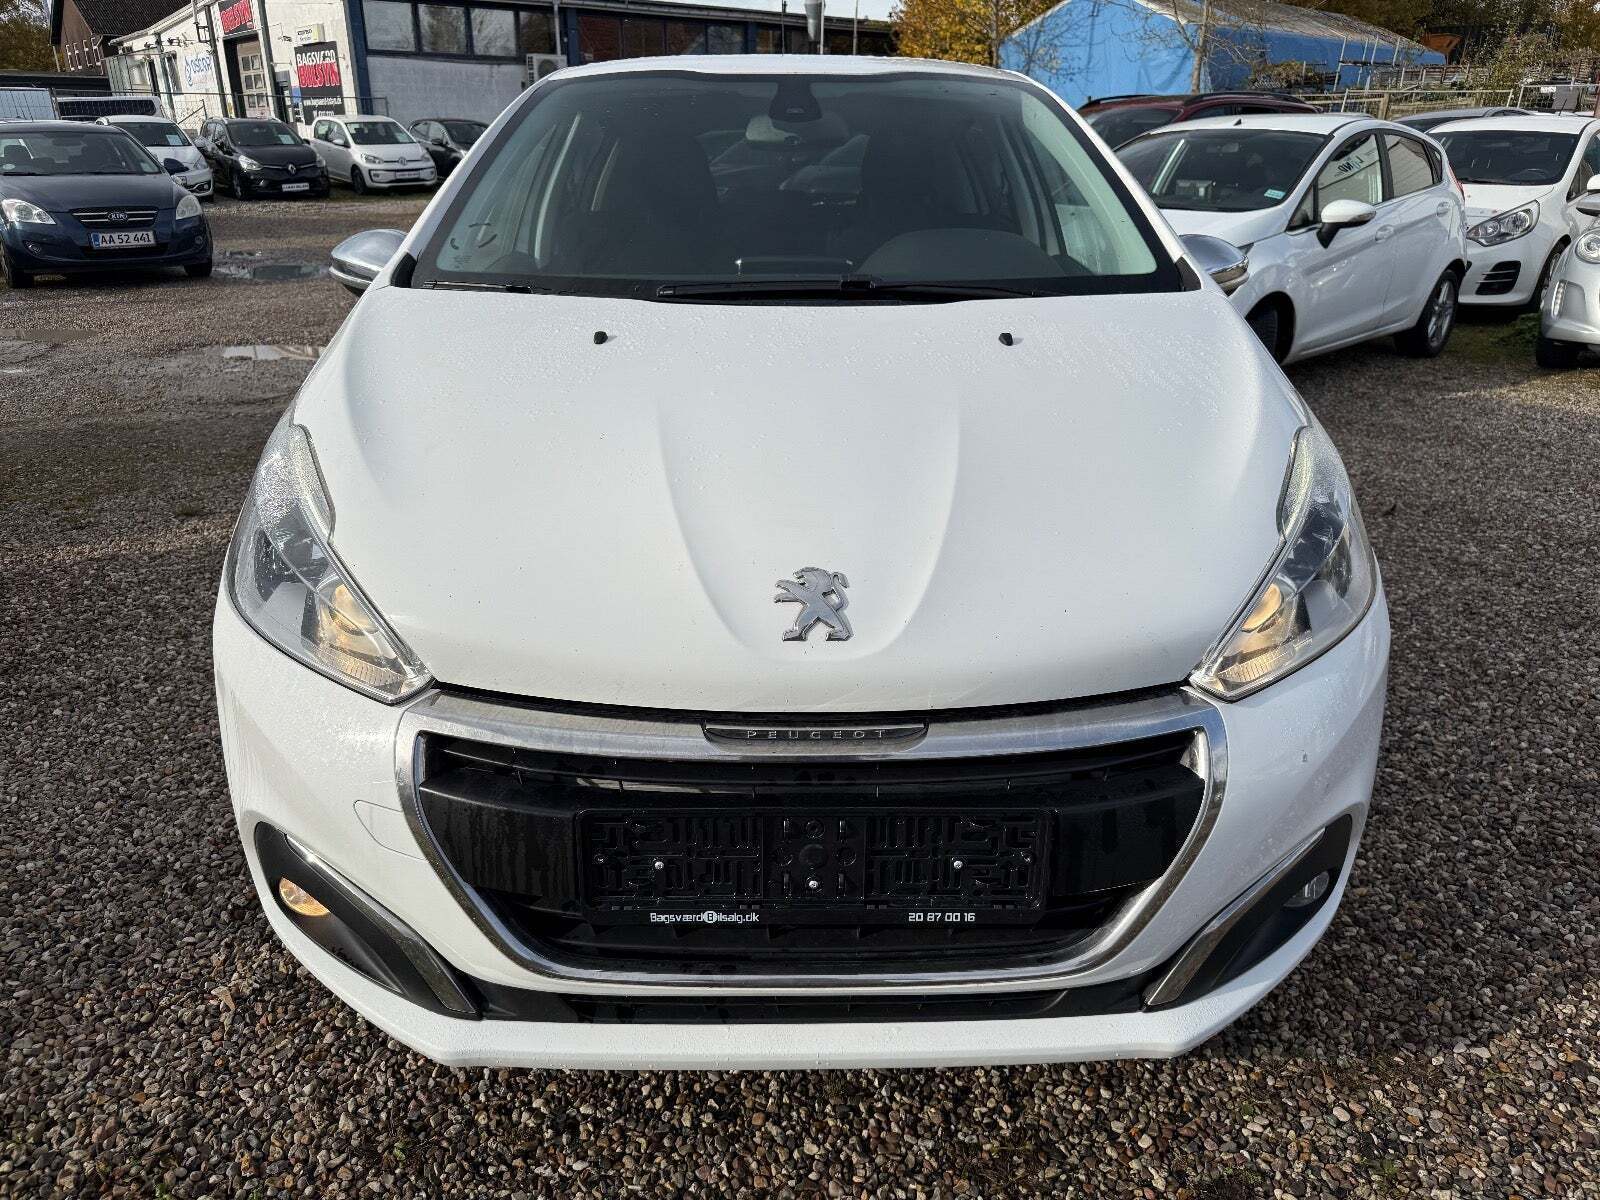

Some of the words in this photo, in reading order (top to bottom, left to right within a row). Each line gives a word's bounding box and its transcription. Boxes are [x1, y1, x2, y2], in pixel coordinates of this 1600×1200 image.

[101, 235, 116, 245] AA
[117, 234, 131, 244] 52
[133, 232, 152, 243] 441
[747, 729, 886, 739] PEUGEOT
[908, 912, 924, 922] 20
[927, 912, 942, 922] 87
[945, 912, 961, 922] 00
[964, 912, 976, 922] 16
